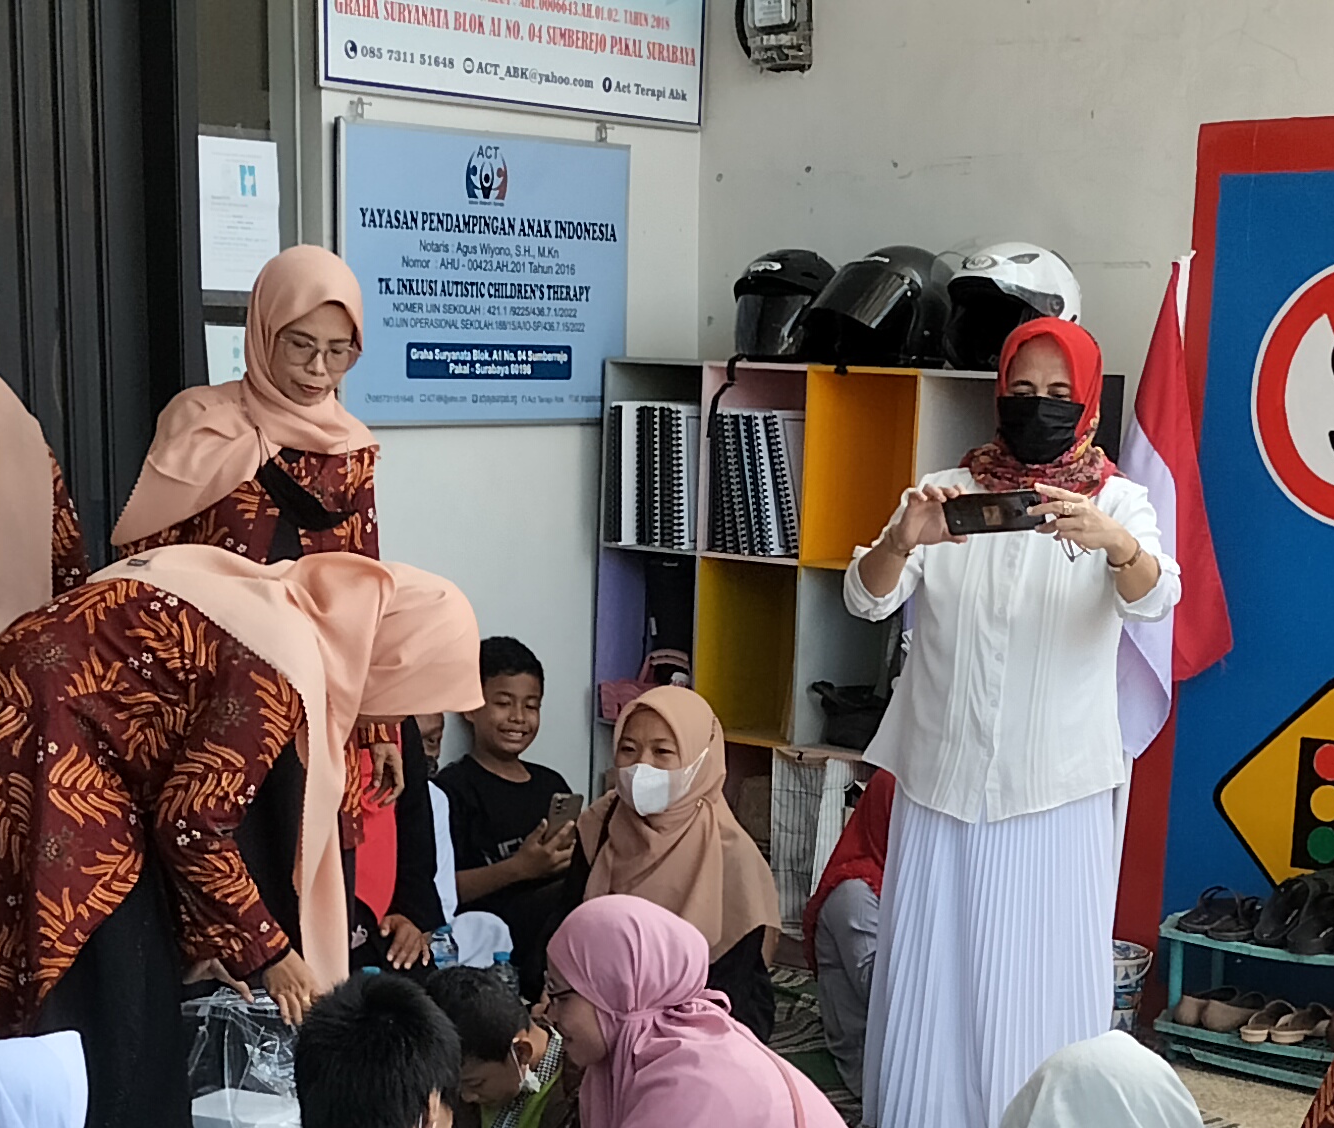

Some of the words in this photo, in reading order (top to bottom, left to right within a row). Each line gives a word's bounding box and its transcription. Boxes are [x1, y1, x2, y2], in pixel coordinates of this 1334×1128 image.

[624, 9, 648, 27] TAHUN
[334, 0, 379, 19] GRAHA
[384, 1, 449, 29] SURYANATA
[454, 11, 485, 35] BLOK
[505, 19, 523, 40] NO.
[528, 23, 542, 43] 04
[546, 26, 607, 54] SUMBEREJO
[610, 36, 643, 59] PAKAL
[646, 41, 696, 66] SURABAYA
[361, 46, 382, 59] 085
[387, 50, 415, 63] 7311
[419, 53, 455, 69] 51648
[614, 81, 631, 94] Act
[634, 83, 666, 101] Terapi
[668, 88, 687, 101] Abk
[477, 145, 499, 159] ACT
[360, 207, 418, 230] YAYASAN
[421, 212, 515, 236] PENDAMPINGAN
[518, 218, 552, 238] ANAK
[555, 220, 617, 242] INDONESIA
[420, 239, 449, 253] Notaris
[456, 242, 477, 257] Agus
[479, 243, 512, 258] Wiyono,
[401, 256, 430, 268] Nomor
[439, 257, 460, 270] AHU
[528, 262, 553, 275] Tahun
[555, 263, 576, 276] 2016
[378, 278, 395, 295] TK.
[397, 278, 438, 297] INKLUSI
[440, 281, 486, 299] AUTISTIC
[487, 283, 545, 301] CHILDREN'S
[547, 285, 591, 303] THERAPY
[393, 302, 424, 313] NOMER
[442, 304, 480, 315] SEKOLAH
